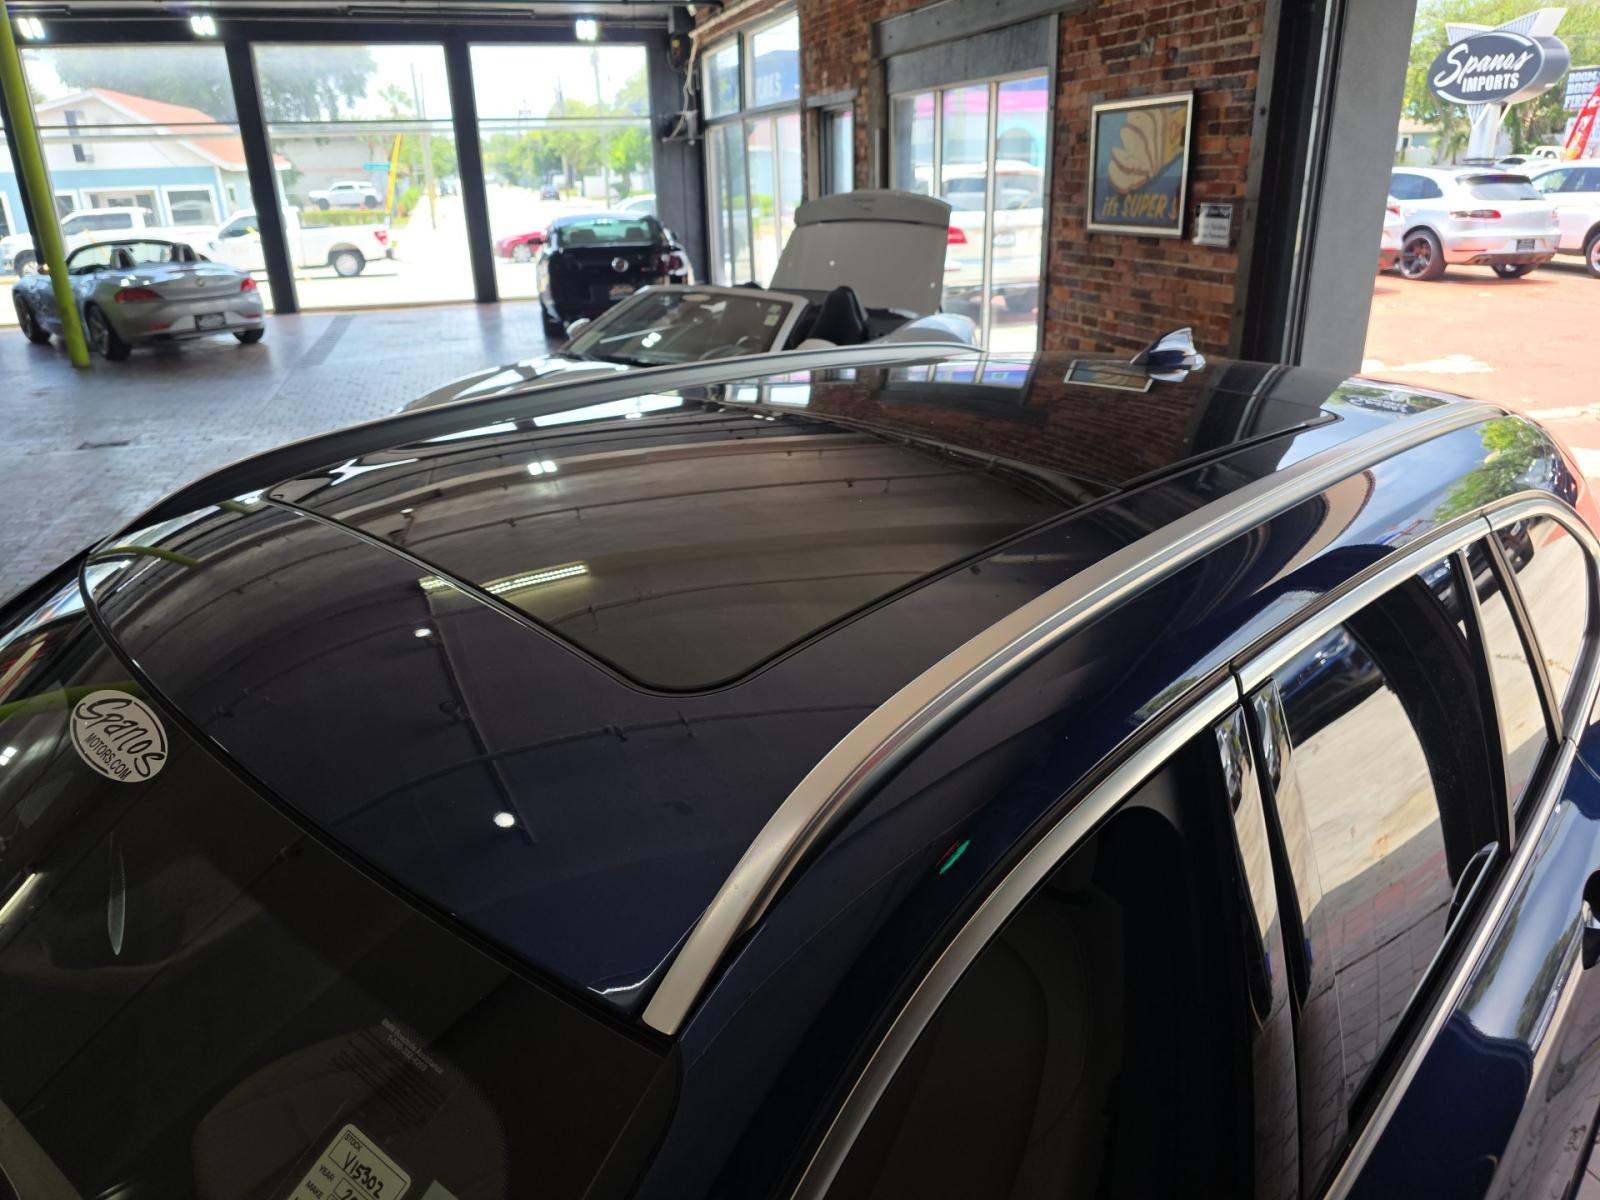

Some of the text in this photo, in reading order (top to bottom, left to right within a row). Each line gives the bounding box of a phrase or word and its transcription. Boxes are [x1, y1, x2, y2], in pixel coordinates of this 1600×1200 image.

[1433, 43, 1534, 88] Spanos
[1461, 72, 1520, 93] IMPORTS
[1122, 194, 1168, 219] SUPER
[75, 698, 165, 778] Spanos
[84, 733, 132, 780] MOTORS.COM
[344, 1133, 363, 1152] STOCK
[318, 1164, 335, 1182] YEAR
